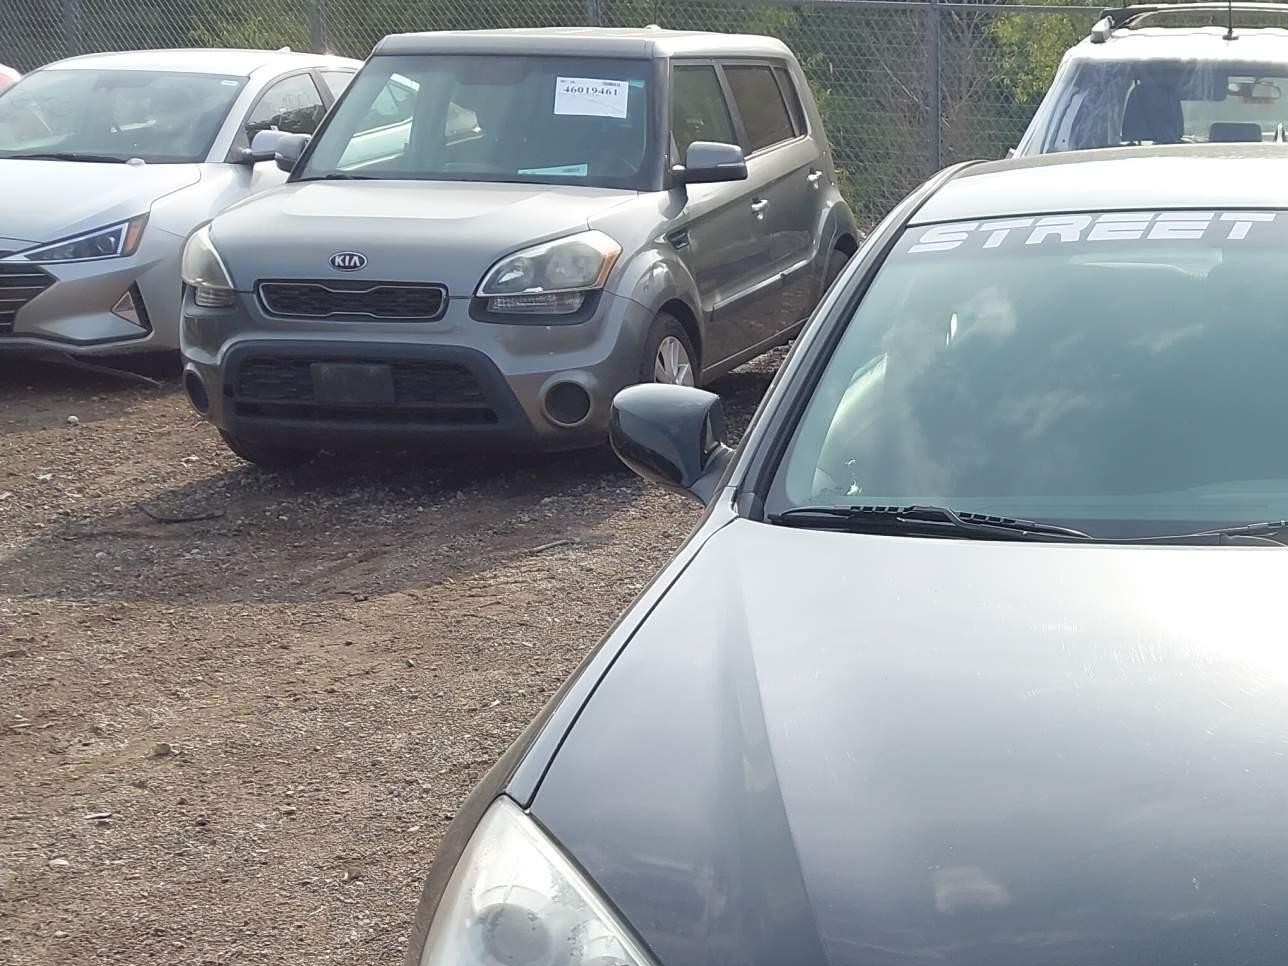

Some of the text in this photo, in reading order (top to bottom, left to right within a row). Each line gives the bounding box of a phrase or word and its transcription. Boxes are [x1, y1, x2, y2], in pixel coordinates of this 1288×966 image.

[563, 85, 618, 96] 46019461
[908, 212, 1277, 254] STREET
[335, 255, 361, 267] KIA
